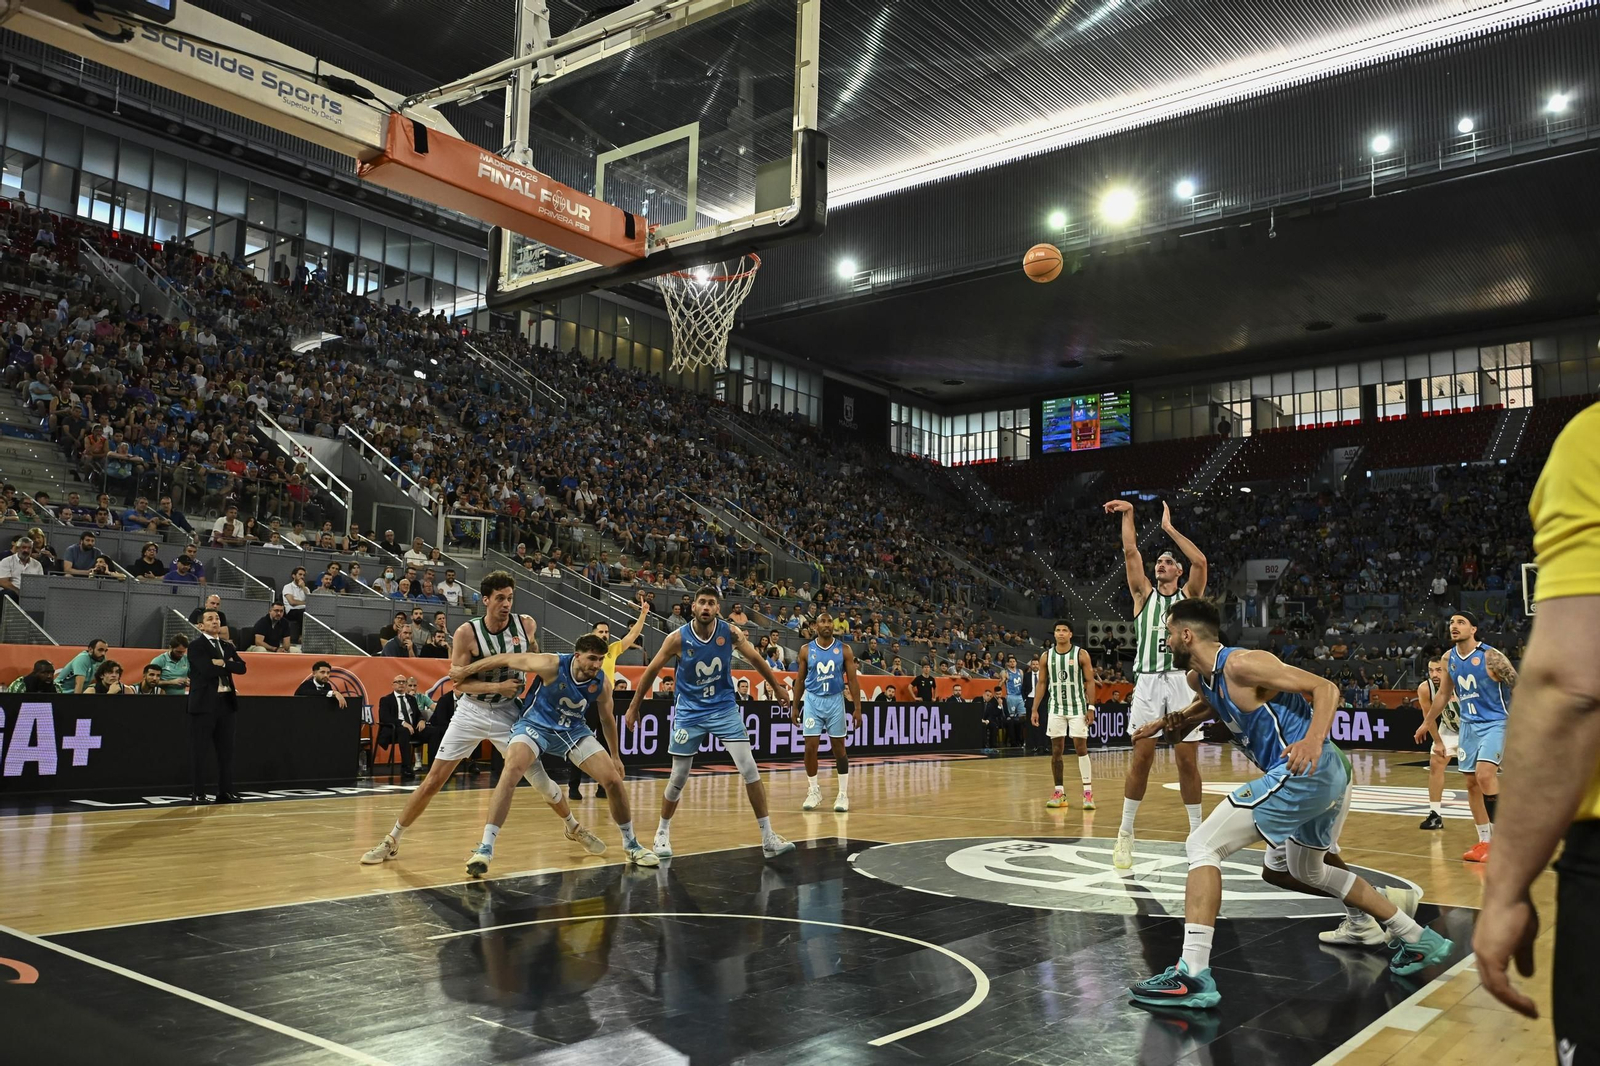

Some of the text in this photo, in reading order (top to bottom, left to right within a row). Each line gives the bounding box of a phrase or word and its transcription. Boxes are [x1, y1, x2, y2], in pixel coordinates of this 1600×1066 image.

[141, 23, 343, 116] Schelde Sports
[283, 96, 343, 125] Superior by Design
[478, 162, 537, 200] FINAL
[538, 206, 591, 232] PRIMERA FEB
[1265, 565, 1279, 573] B02
[703, 685, 715, 698] 29
[823, 682, 829, 691] 11
[1467, 702, 1477, 714] 11
[675, 730, 688, 743] hp
[844, 712, 869, 747] en
[873, 705, 952, 746] LALIGA+
[1090, 706, 1124, 744] Sigue
[1328, 710, 1390, 742] GA+
[982, 843, 1050, 855] FEB
